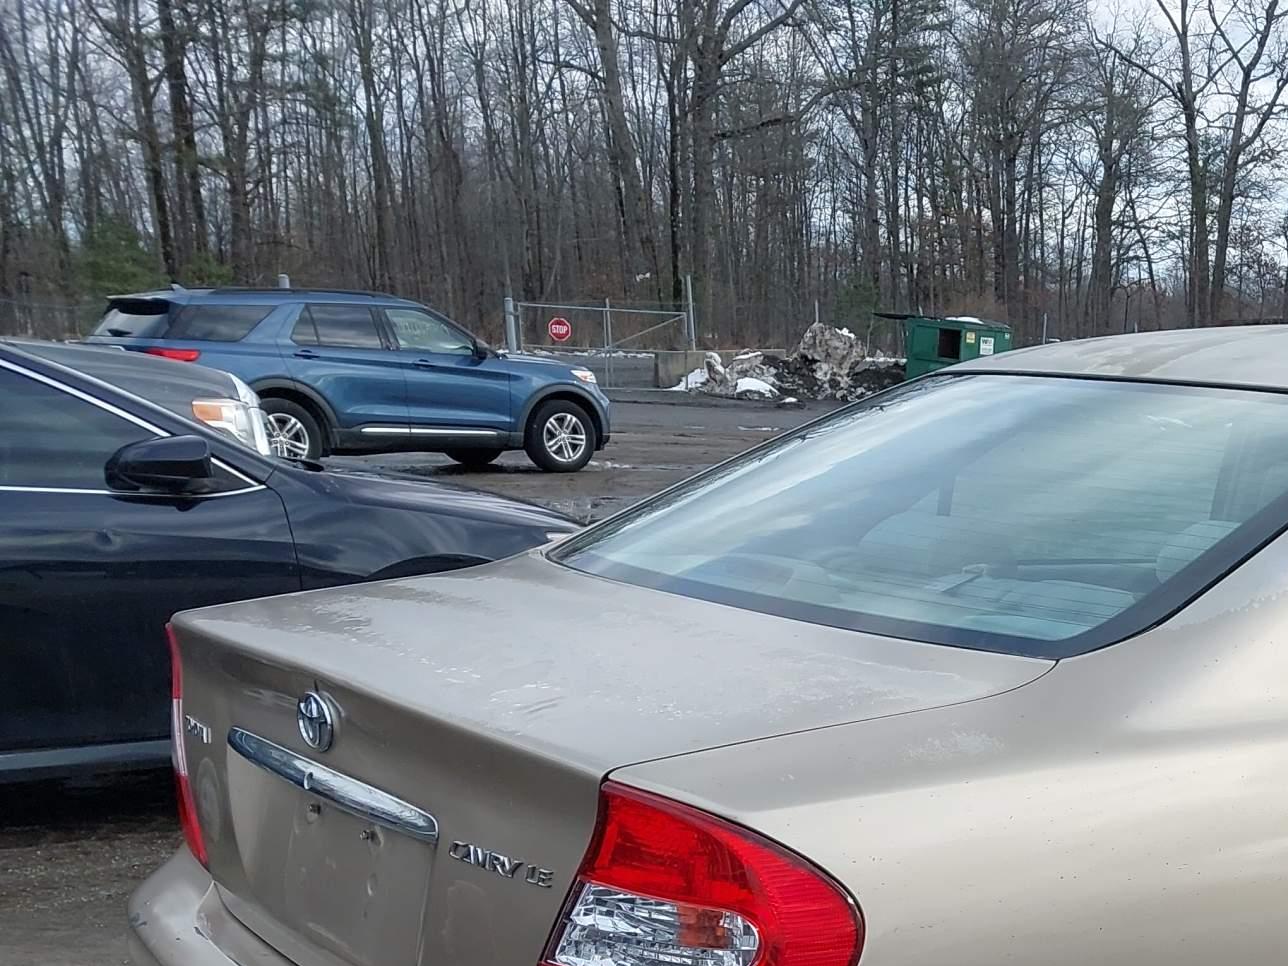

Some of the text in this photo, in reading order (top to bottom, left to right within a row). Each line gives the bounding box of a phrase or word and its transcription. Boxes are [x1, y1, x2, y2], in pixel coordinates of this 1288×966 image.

[551, 324, 568, 334] STOP
[449, 840, 554, 888] CAMRY LE
